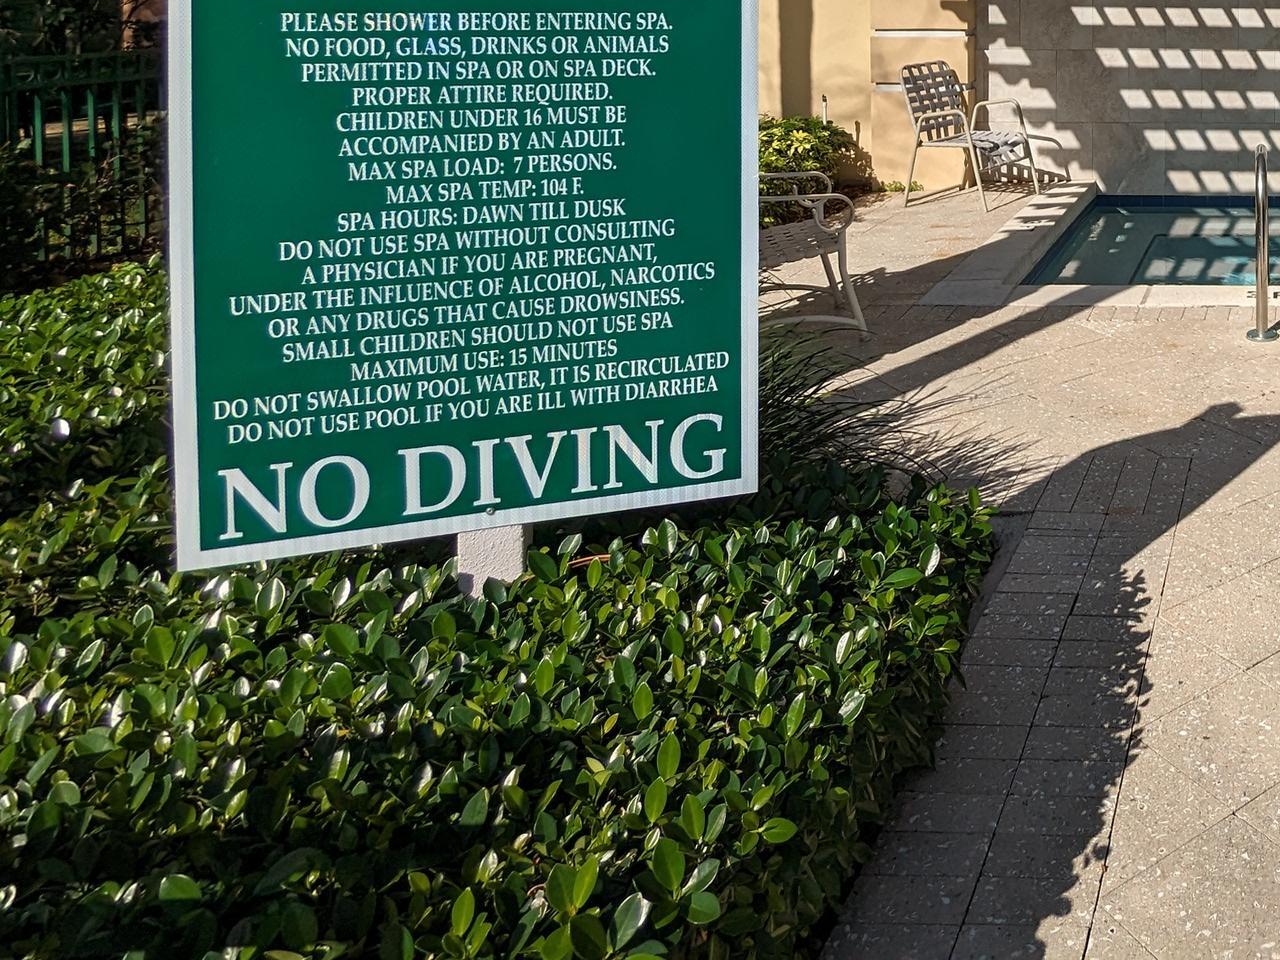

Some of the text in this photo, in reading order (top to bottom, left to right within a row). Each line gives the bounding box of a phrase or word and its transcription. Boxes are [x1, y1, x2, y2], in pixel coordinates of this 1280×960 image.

[281, 12, 673, 33] PLEASE SHOWER BEFORE ENTERING SPA.
[285, 35, 670, 59] NO FOOD, GLASS, DRINKS OR ANIMALS
[301, 58, 656, 83] PERMITTED IN SPA OR ON SPA DECK.
[352, 82, 613, 107] PROPER ATTIRE REQUIRED.
[336, 105, 627, 132] CHILDREN UNDER 16 MUST BE
[338, 128, 626, 157] ACCOMPANIED BY AN ADULT.
[348, 152, 617, 182] MAX SPA LOAD: 7 PERSONS.
[386, 176, 584, 205] MAX SPA TEMP: 104 F.
[338, 198, 626, 233] SPA HOURS: DAWN TILL DUSK
[279, 218, 676, 261] DO NOT USE SPA WITHOUT CONSULTING
[301, 243, 658, 285] A PHYSICIAN IF YOU ARE PREGNANT,
[229, 261, 715, 316] UNDER THE INFLUENCE OF ALCOHOL, NARCOTICS
[268, 287, 685, 339] OR ANY DRUGS THAT CAUSE DROWSINESS.
[282, 311, 674, 363] SMALL CHILDREN SHOULD NOT USE SPA
[350, 338, 618, 382] MAXIMUM USE: 15 MINUTES
[213, 351, 730, 421] DO NOT SWALLOW POOL WATER, IT IS RECIRCULATED
[227, 375, 719, 445] DO NOT USE POOL IF YOU ARE ILL WITH DIARRHEA
[217, 413, 727, 541] NO DIVING
